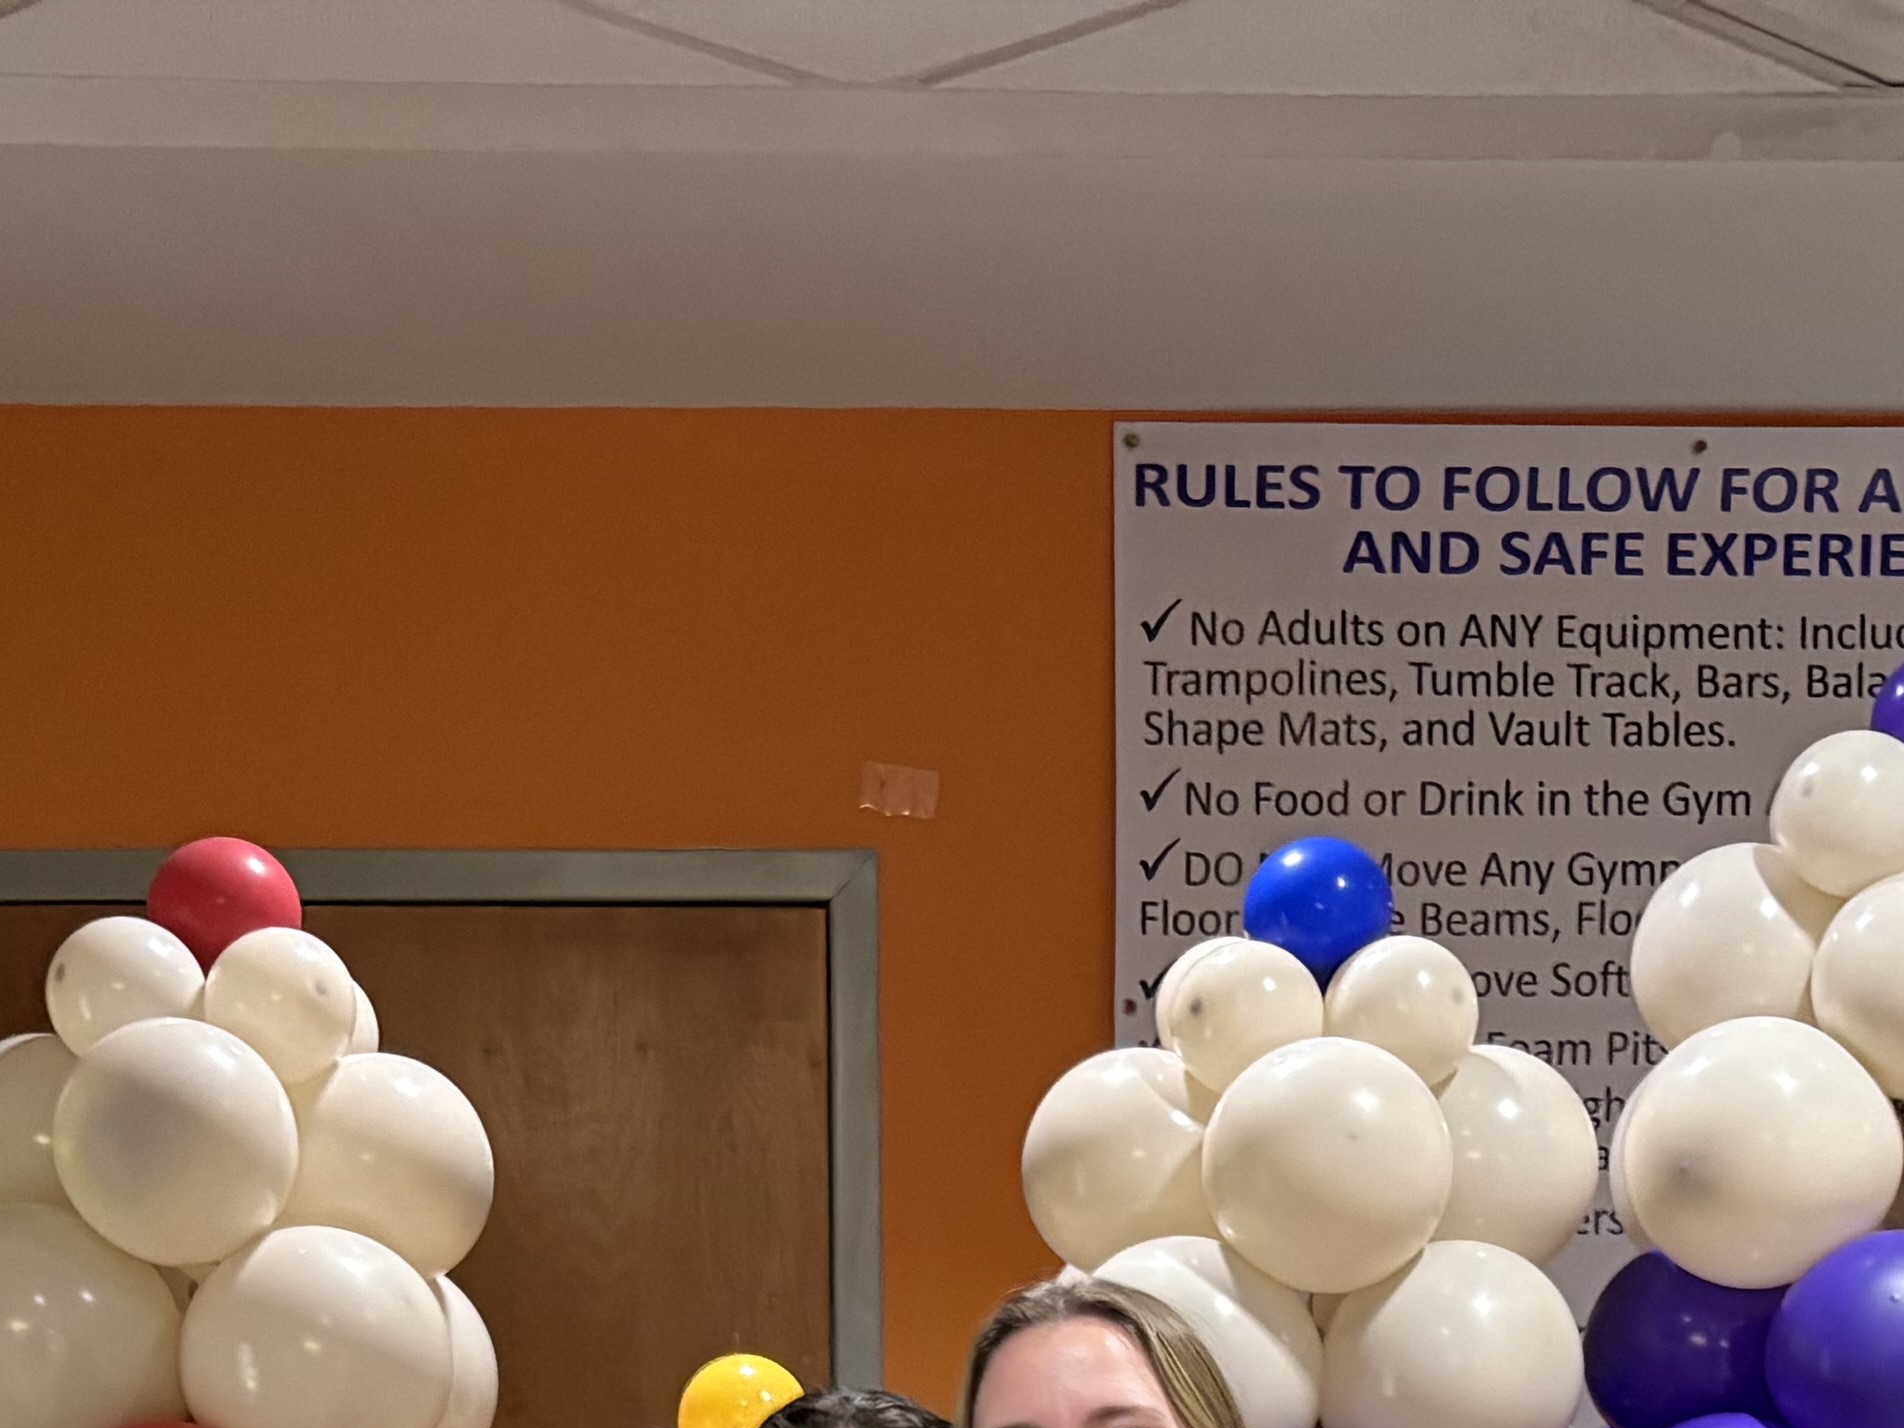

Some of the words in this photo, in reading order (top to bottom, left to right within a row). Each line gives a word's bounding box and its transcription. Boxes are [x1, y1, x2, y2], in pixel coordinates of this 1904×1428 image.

[1135, 463, 1321, 510] RULES
[1337, 465, 1421, 511] TO
[1443, 465, 1701, 513] FOLLOW
[1720, 467, 1840, 514] FOR
[1857, 468, 1902, 514] A
[1342, 530, 1480, 575] AND
[1499, 530, 1645, 576] SAFE
[1191, 610, 1245, 647] No
[1257, 608, 1384, 647] Adults
[1396, 620, 1446, 647] on
[1459, 613, 1544, 649] ANY
[1557, 614, 1784, 658] Equipment:
[1143, 658, 1398, 706] Trampolines,
[1407, 660, 1555, 698] Tumble
[1566, 661, 1681, 705] Track,
[1697, 664, 1791, 705] Bars,
[1807, 661, 1887, 699] Bala
[1144, 708, 1264, 755] Shape
[1279, 711, 1388, 753] Mats,
[1402, 709, 1475, 746] and
[1487, 710, 1591, 747] Vault
[1601, 710, 1736, 748] Tables.
[1185, 781, 1240, 817] No
[1254, 779, 1350, 817] Food
[1364, 789, 1407, 817] or
[1420, 778, 1524, 817] Drink
[1538, 780, 1570, 817] in
[1583, 779, 1649, 817] the
[1662, 781, 1751, 825] Gym
[1185, 851, 1243, 887] DO
[1479, 851, 1555, 896] Any
[1138, 898, 1241, 937] Floor
[1420, 902, 1560, 944] Beams,
[1472, 969, 1540, 999] ove
[1549, 959, 1632, 999] Soft
